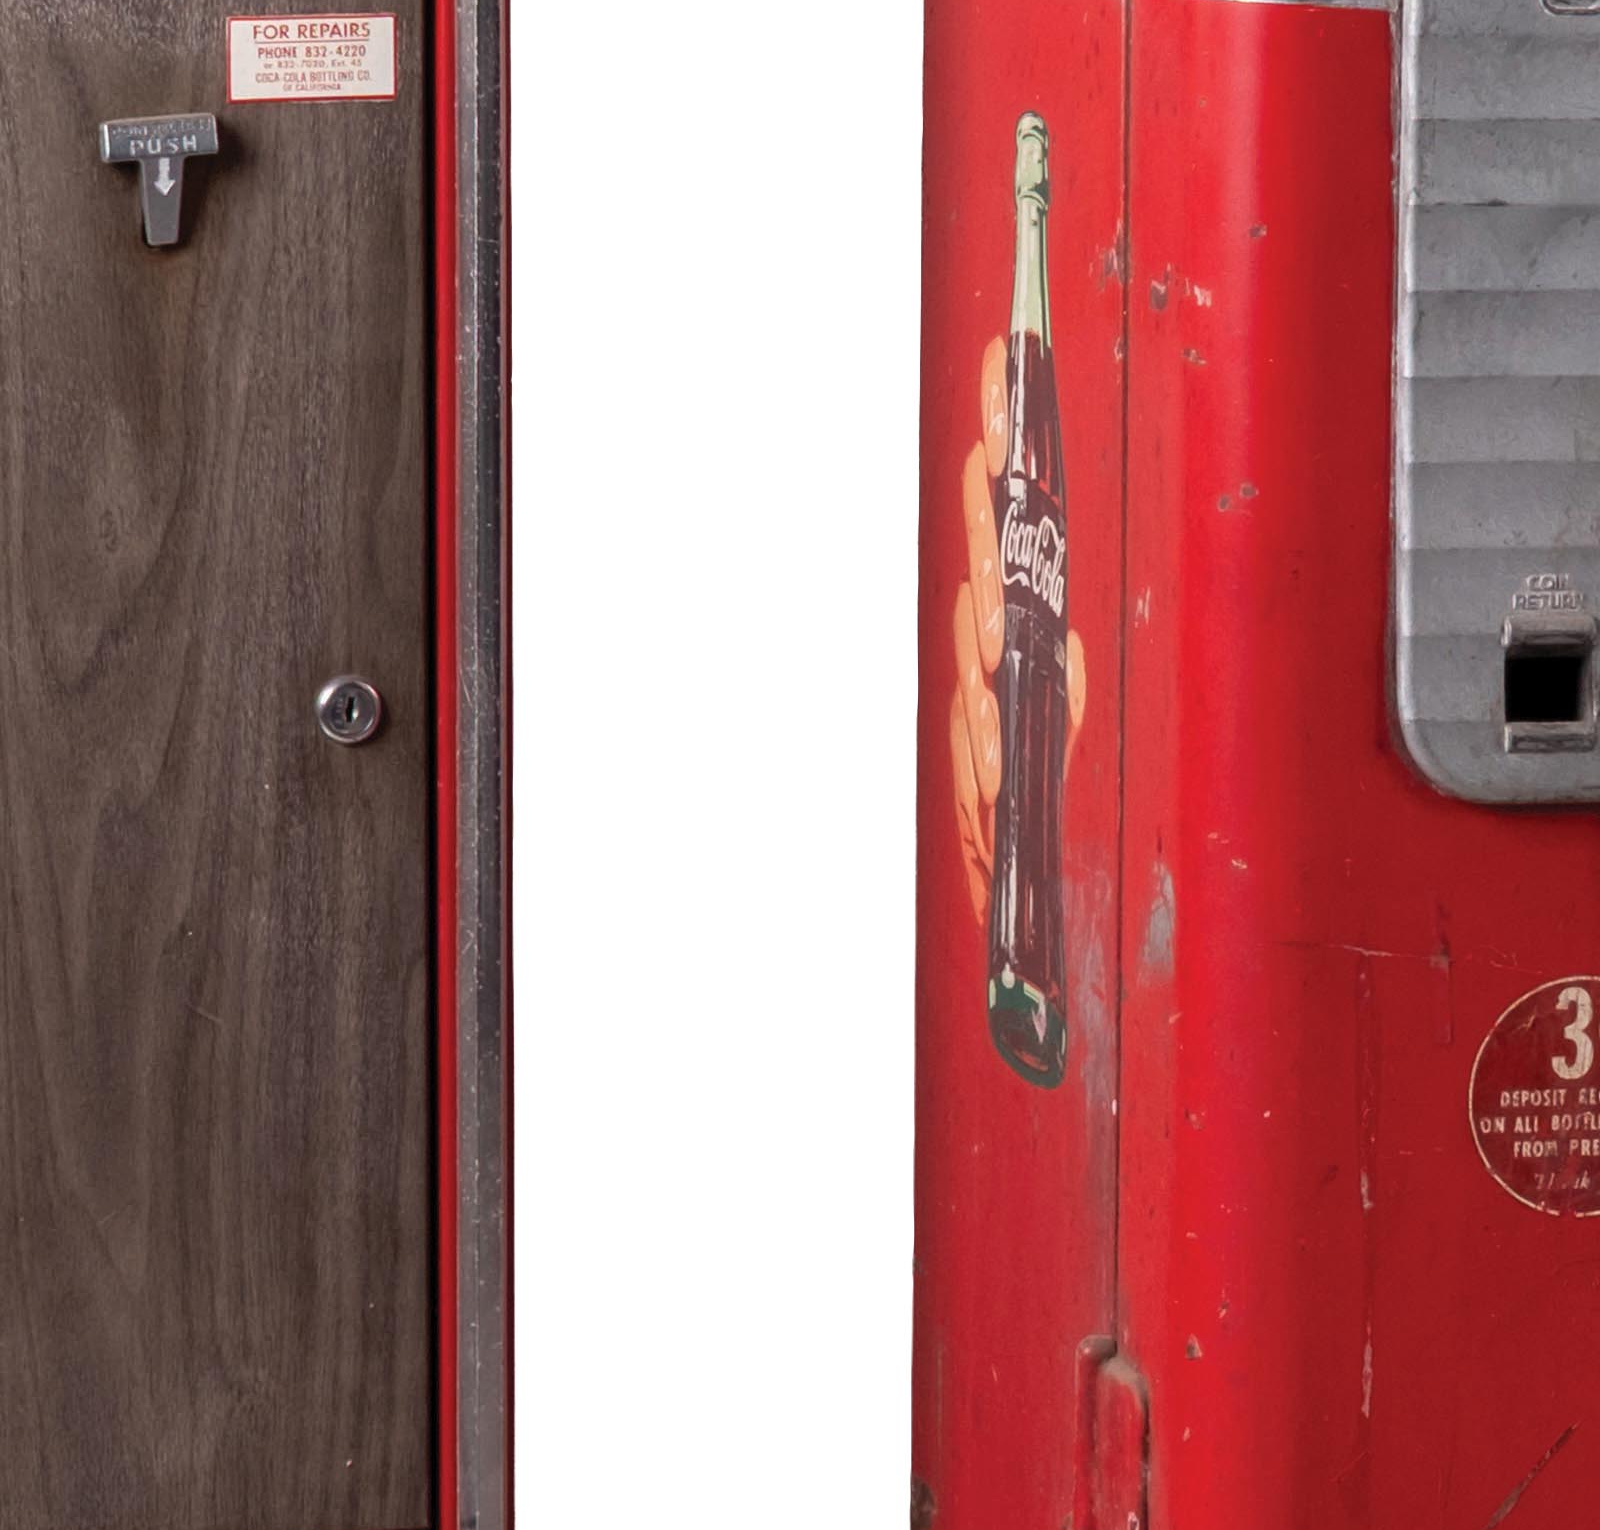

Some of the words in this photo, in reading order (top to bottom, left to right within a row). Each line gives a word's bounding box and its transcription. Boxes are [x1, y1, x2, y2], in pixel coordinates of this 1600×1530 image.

[253, 24, 289, 40] FOR
[297, 22, 371, 39] REPAIRS
[257, 47, 297, 59] PHONE
[129, 134, 198, 156] PUSH
[1001, 500, 1066, 618] Coca-Cola
[1500, 1088, 1567, 1108] DEPOSIT
[1480, 1118, 1506, 1134] ON
[1513, 1140, 1559, 1158] FROM
